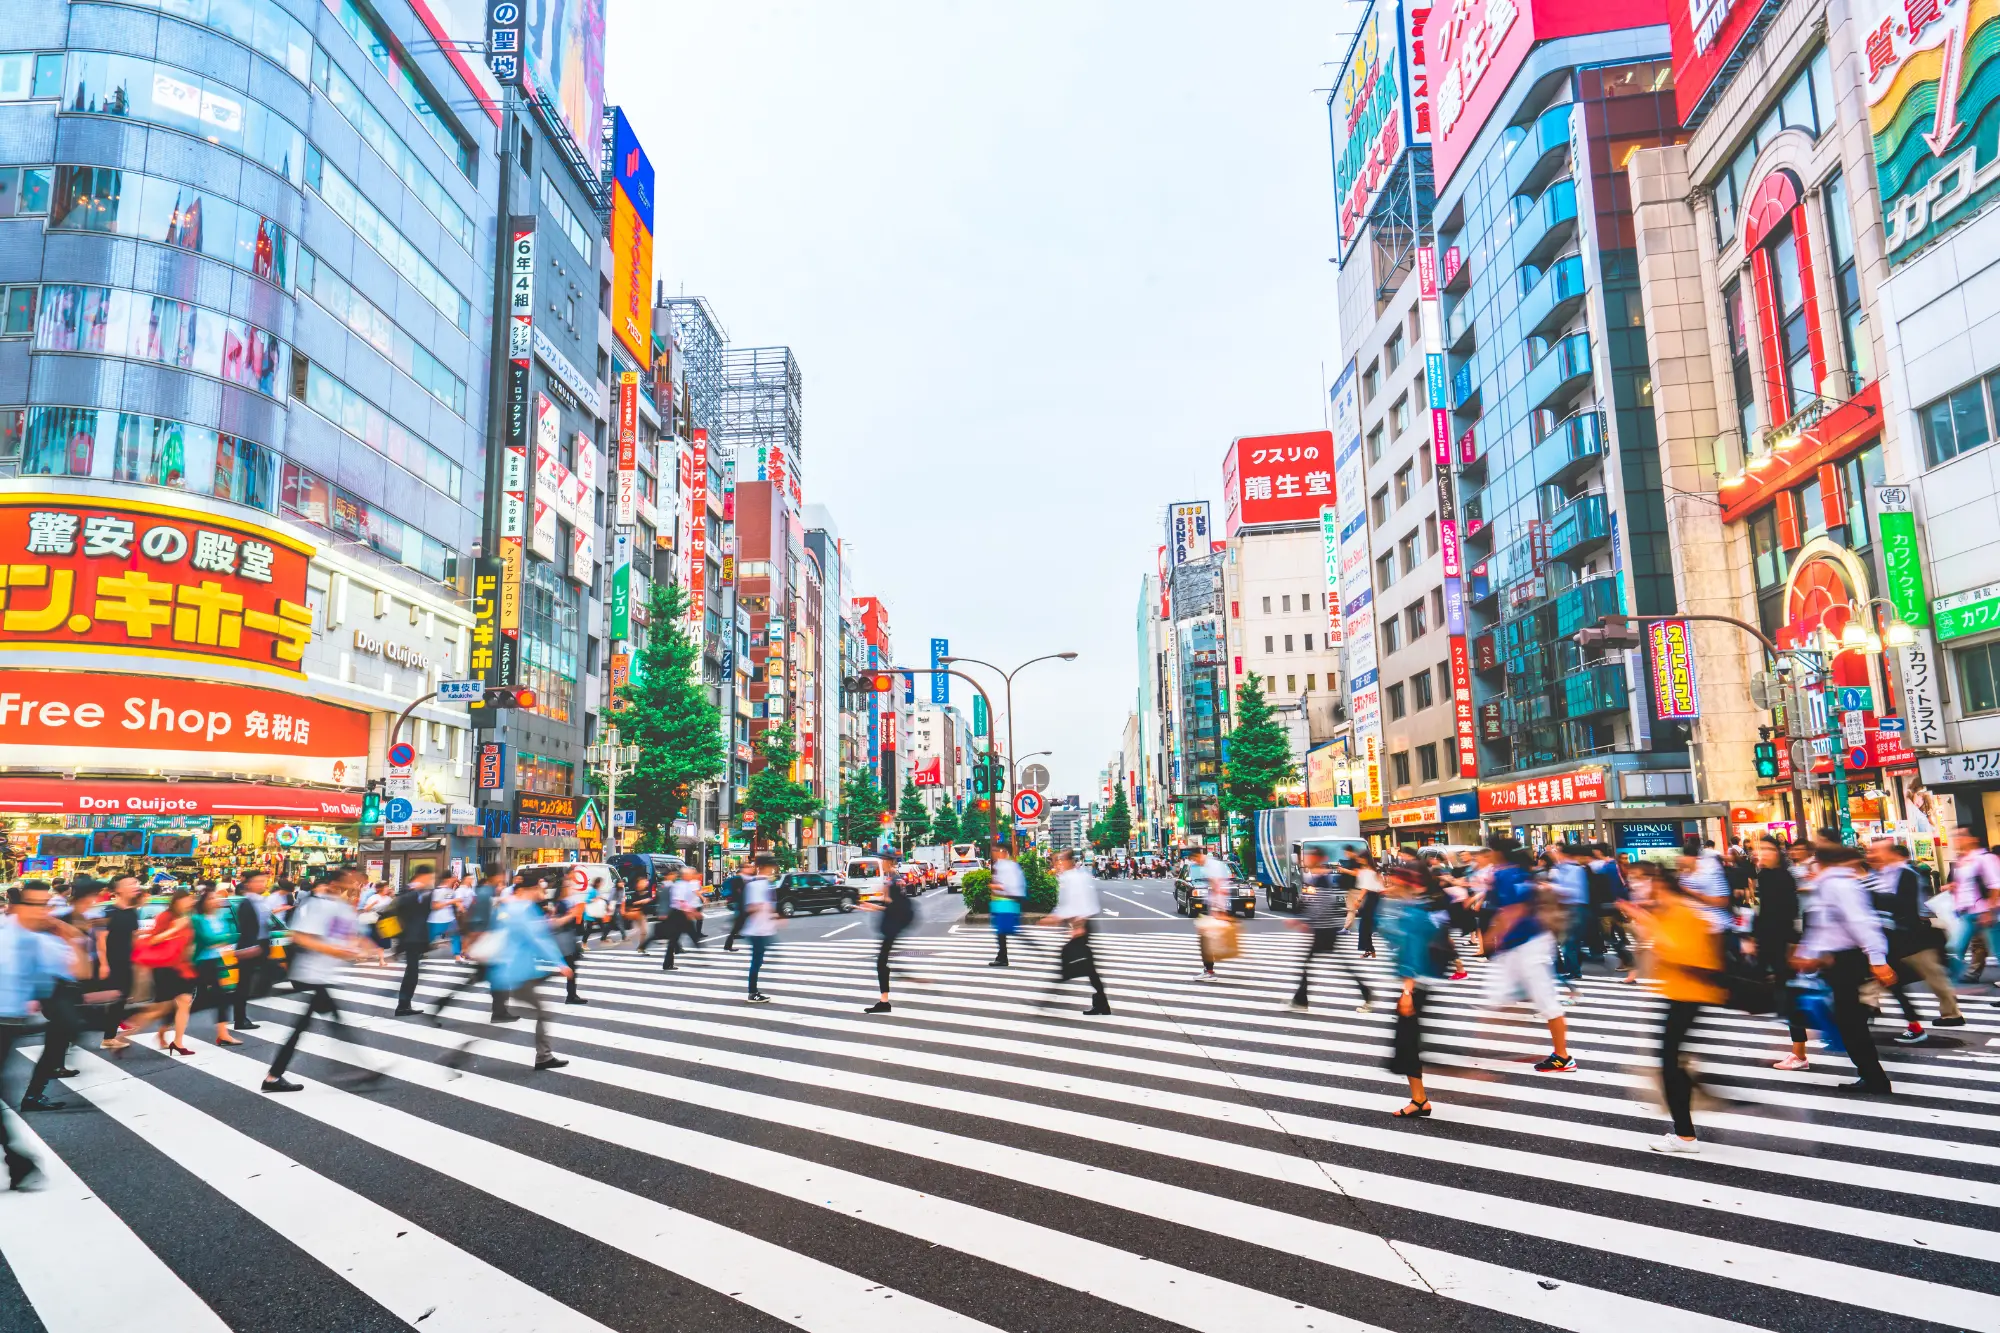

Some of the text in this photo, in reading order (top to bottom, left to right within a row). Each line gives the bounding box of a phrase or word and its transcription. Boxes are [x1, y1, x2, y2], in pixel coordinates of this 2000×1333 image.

[510, 455, 519, 487] 手羽一郎
[693, 438, 707, 499] カラオケ
[1251, 446, 1319, 465] クスリの
[1244, 470, 1332, 502] 龍生堂
[508, 500, 516, 532] 北の家族
[26, 511, 275, 584] 驚安の殿堂
[1323, 512, 1337, 585] 新宿サンパーク
[1892, 534, 1920, 623] カワノ・クォーク
[614, 585, 626, 617] レイク
[1328, 591, 1342, 642] 三平本館
[1936, 598, 1950, 611] 3F
[353, 629, 430, 670] Don Quijote
[722, 652, 731, 677] 747
[1668, 626, 1692, 712] ネットカフェ
[440, 682, 481, 693] 歌舞伎町
[1909, 650, 1937, 744] カワノ・トラスト
[0, 692, 235, 743] Free Shop
[245, 711, 311, 745] 免税店
[79, 796, 198, 811] Don Quijote
[321, 802, 364, 818] Don Quijo
[391, 803, 402, 820] P
[1622, 823, 1674, 832] SUBNADE
